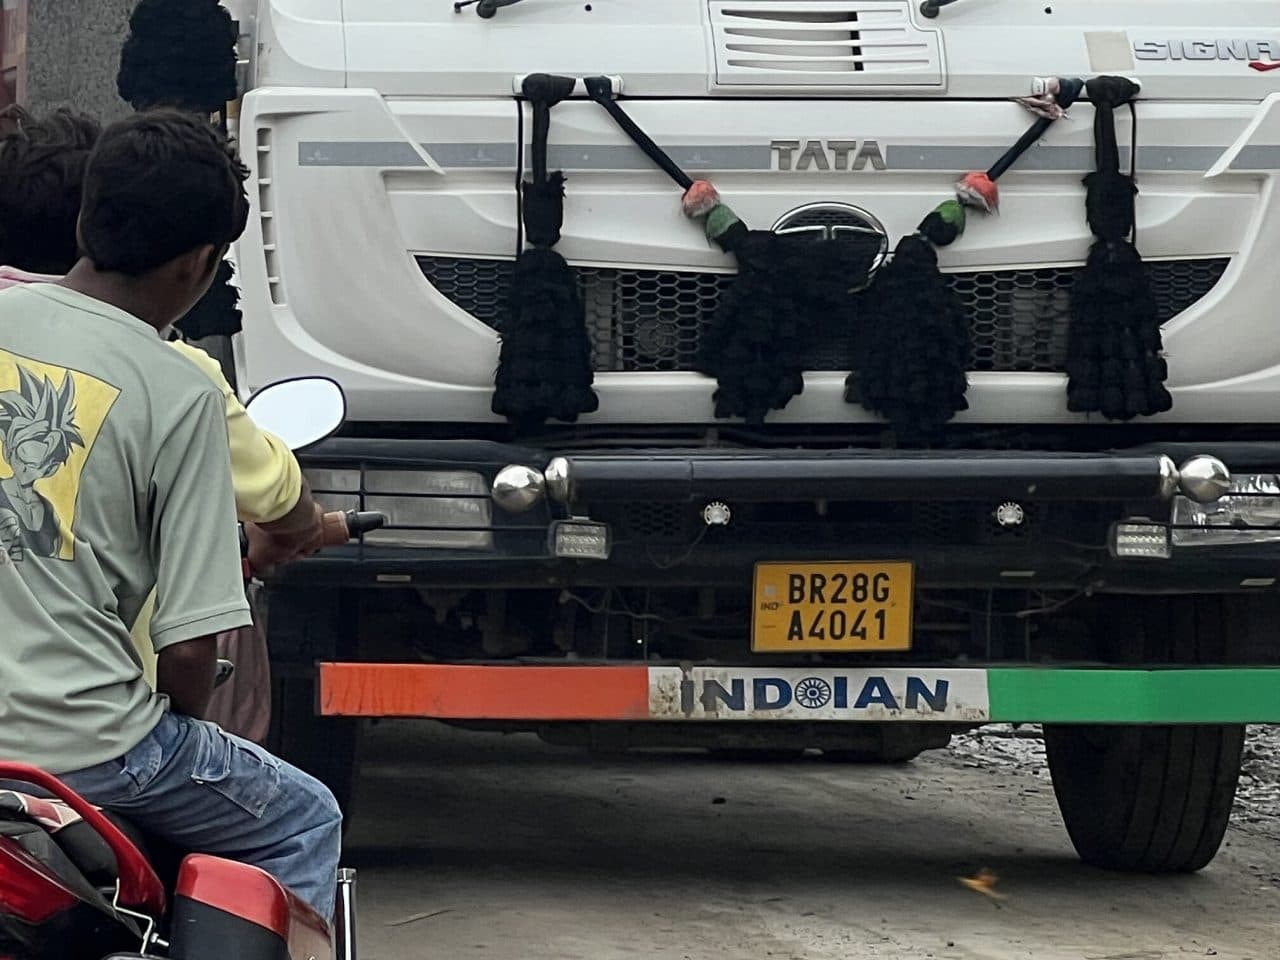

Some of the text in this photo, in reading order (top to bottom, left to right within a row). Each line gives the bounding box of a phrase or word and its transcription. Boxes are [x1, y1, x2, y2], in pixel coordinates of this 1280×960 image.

[771, 140, 888, 171] TATA
[788, 572, 891, 604] BR28G
[787, 608, 887, 641] A4041
